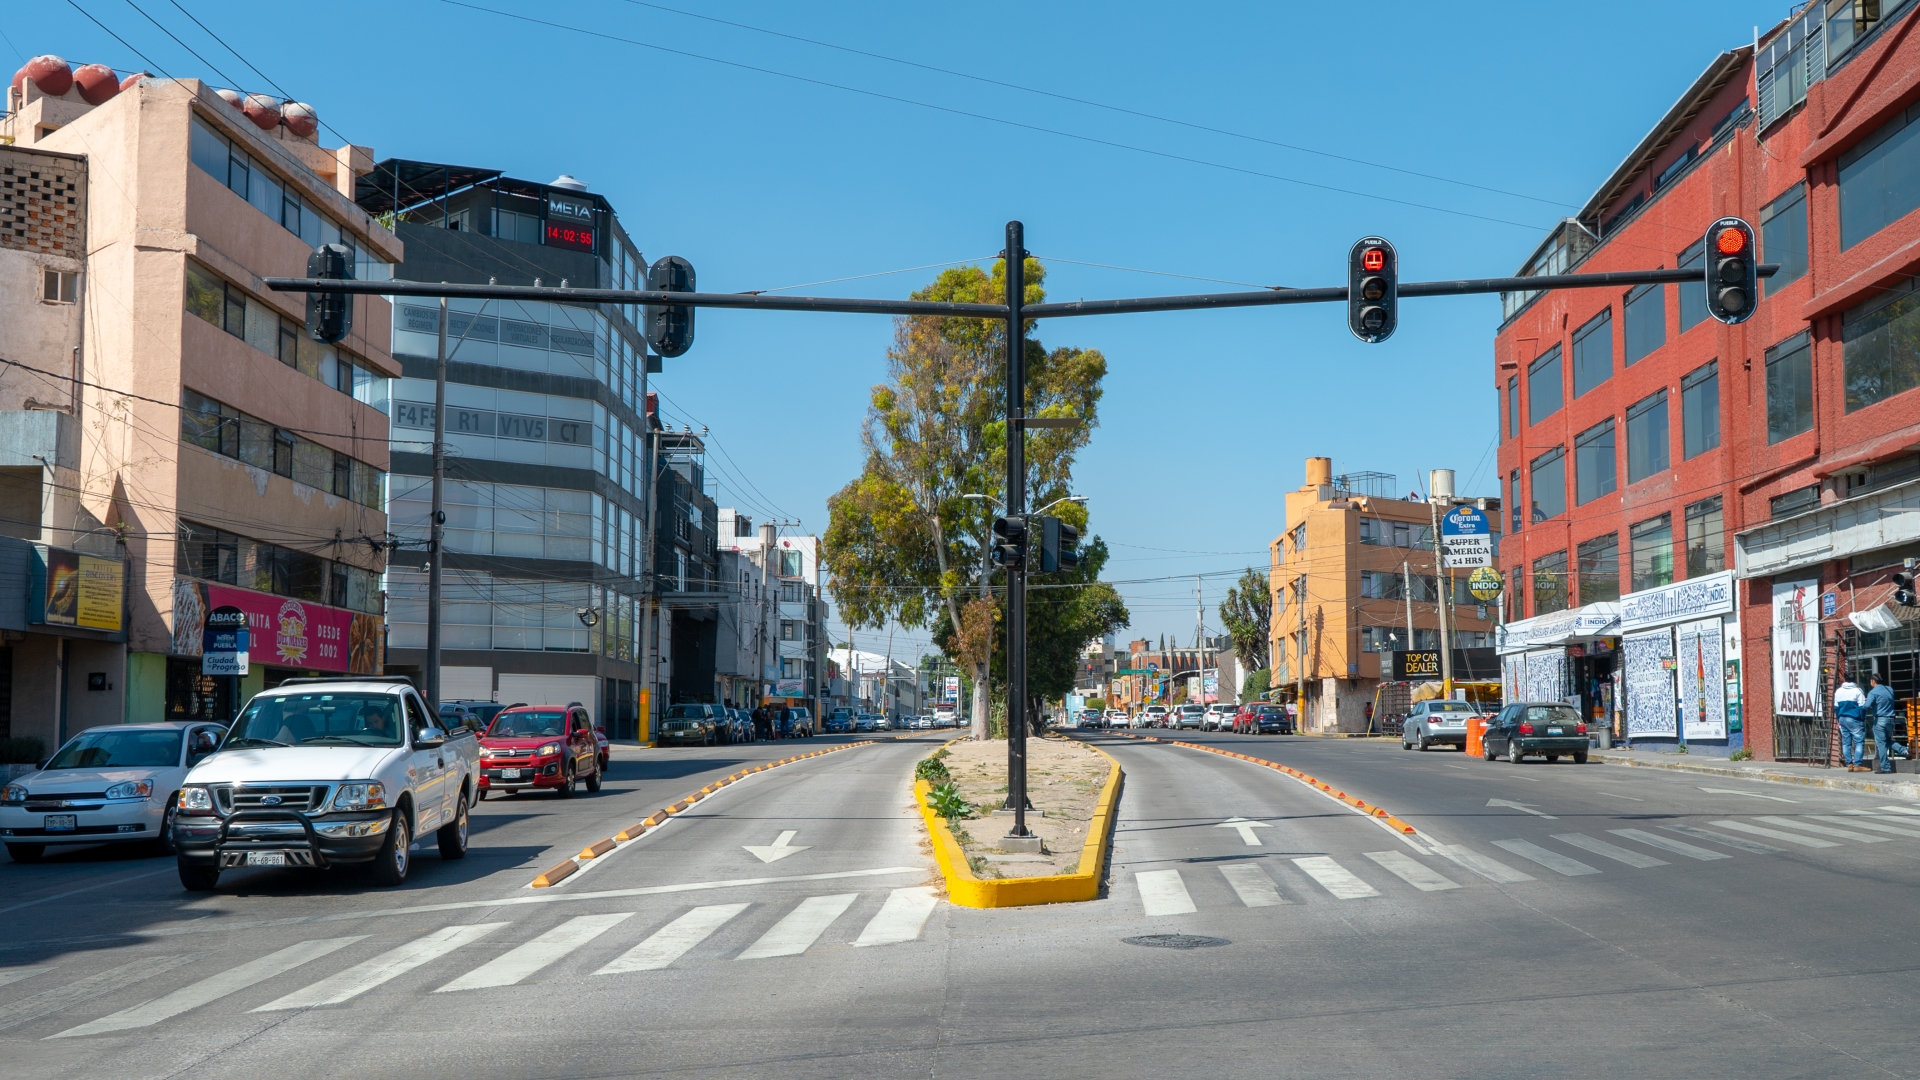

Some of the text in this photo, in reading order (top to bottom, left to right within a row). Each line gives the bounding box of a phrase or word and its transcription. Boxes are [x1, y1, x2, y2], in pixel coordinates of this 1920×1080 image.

[550, 200, 591, 218] META
[548, 226, 592, 245] 14:02:55
[403, 307, 438, 321] CAMBIOS DE
[407, 318, 433, 331] RÉGIMEN
[450, 319, 496, 334] RECTIFIACIONES
[506, 322, 542, 336] OPERACIONES
[510, 332, 539, 344] VIRTUALES
[397, 404, 417, 424] F4
[458, 411, 479, 431] R1
[560, 423, 580, 442] CT
[1449, 513, 1481, 524] Corona
[1449, 538, 1480, 546] SUPER
[1447, 547, 1489, 556] AMERICA
[1464, 556, 1484, 565] HRS
[1472, 581, 1499, 590] INDIO
[209, 612, 244, 623] ÁBACO
[317, 624, 341, 640] DESDE
[319, 644, 338, 658] 2002
[1405, 653, 1438, 662] TOP CAR
[207, 656, 235, 664] Ciudad
[1780, 649, 1811, 671] TACOS
[211, 664, 246, 672] Progreso
[1405, 662, 1439, 673] DEALER
[1788, 672, 1799, 690] DE
[1780, 692, 1815, 713] ASADA
